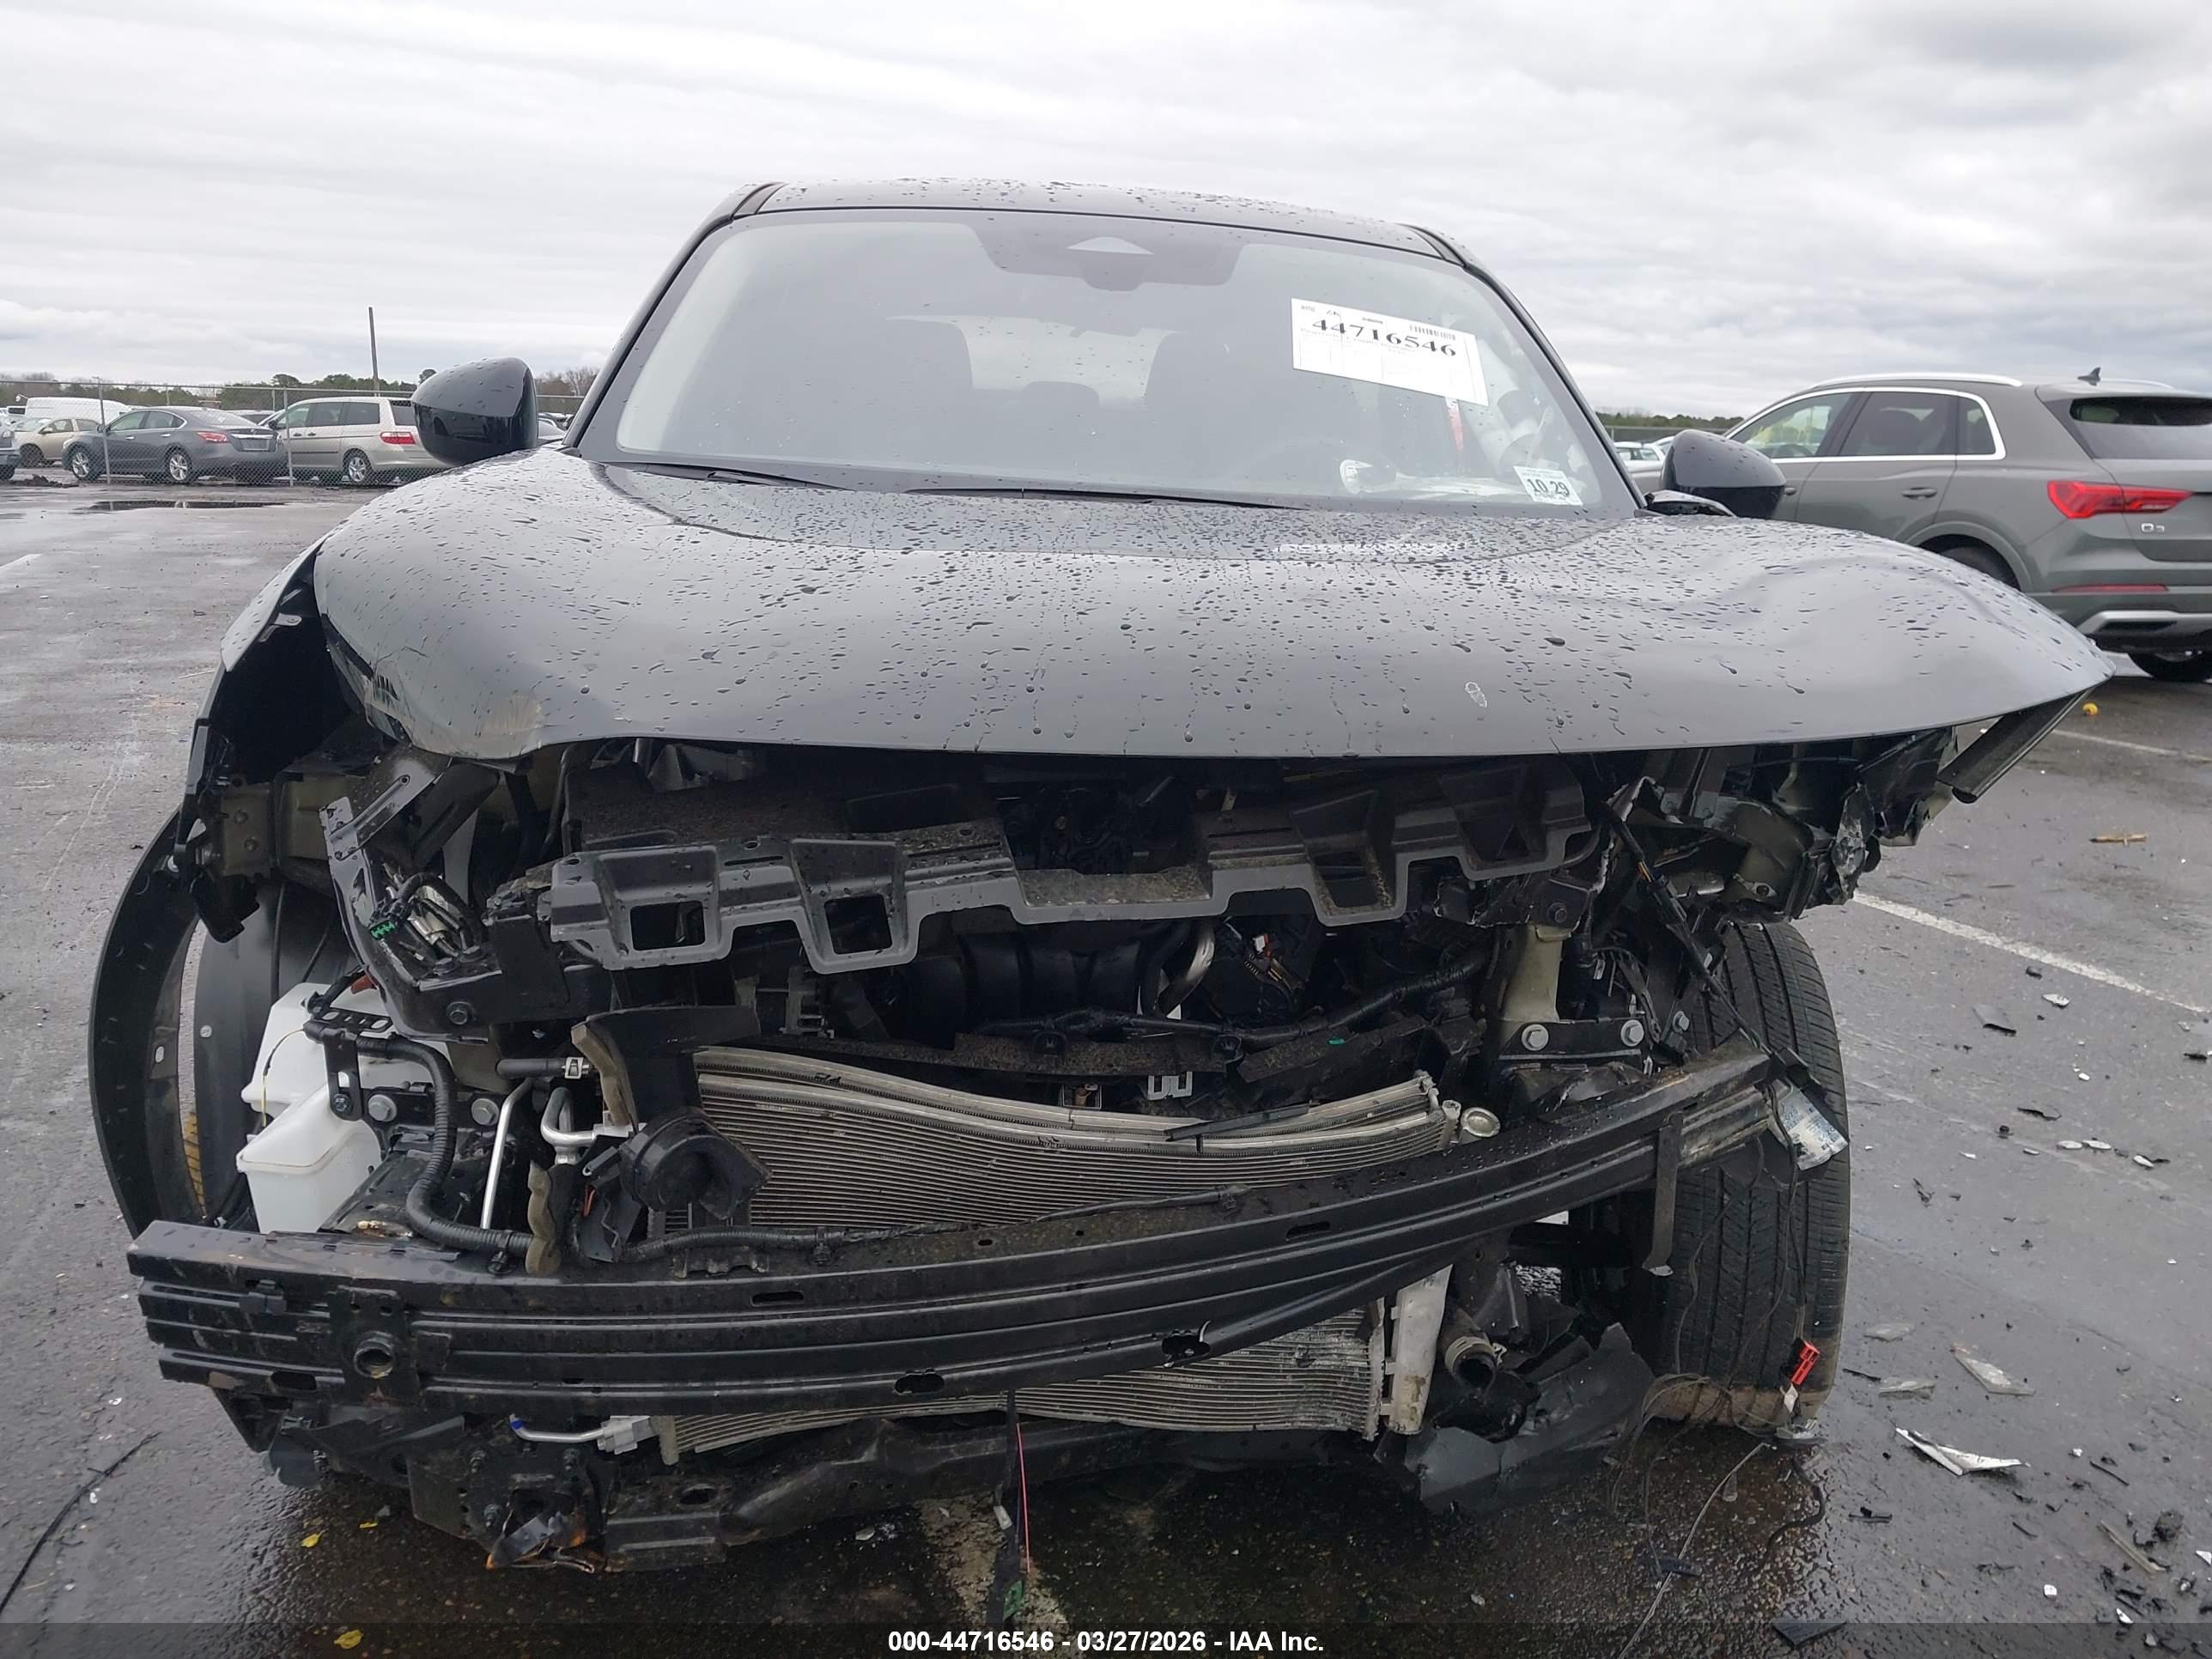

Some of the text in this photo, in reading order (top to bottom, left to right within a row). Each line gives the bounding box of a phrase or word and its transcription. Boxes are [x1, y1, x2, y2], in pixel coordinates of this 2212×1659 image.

[1312, 319, 1456, 356] 44716546
[1527, 478, 1548, 494] 10
[1549, 480, 1571, 497] 29
